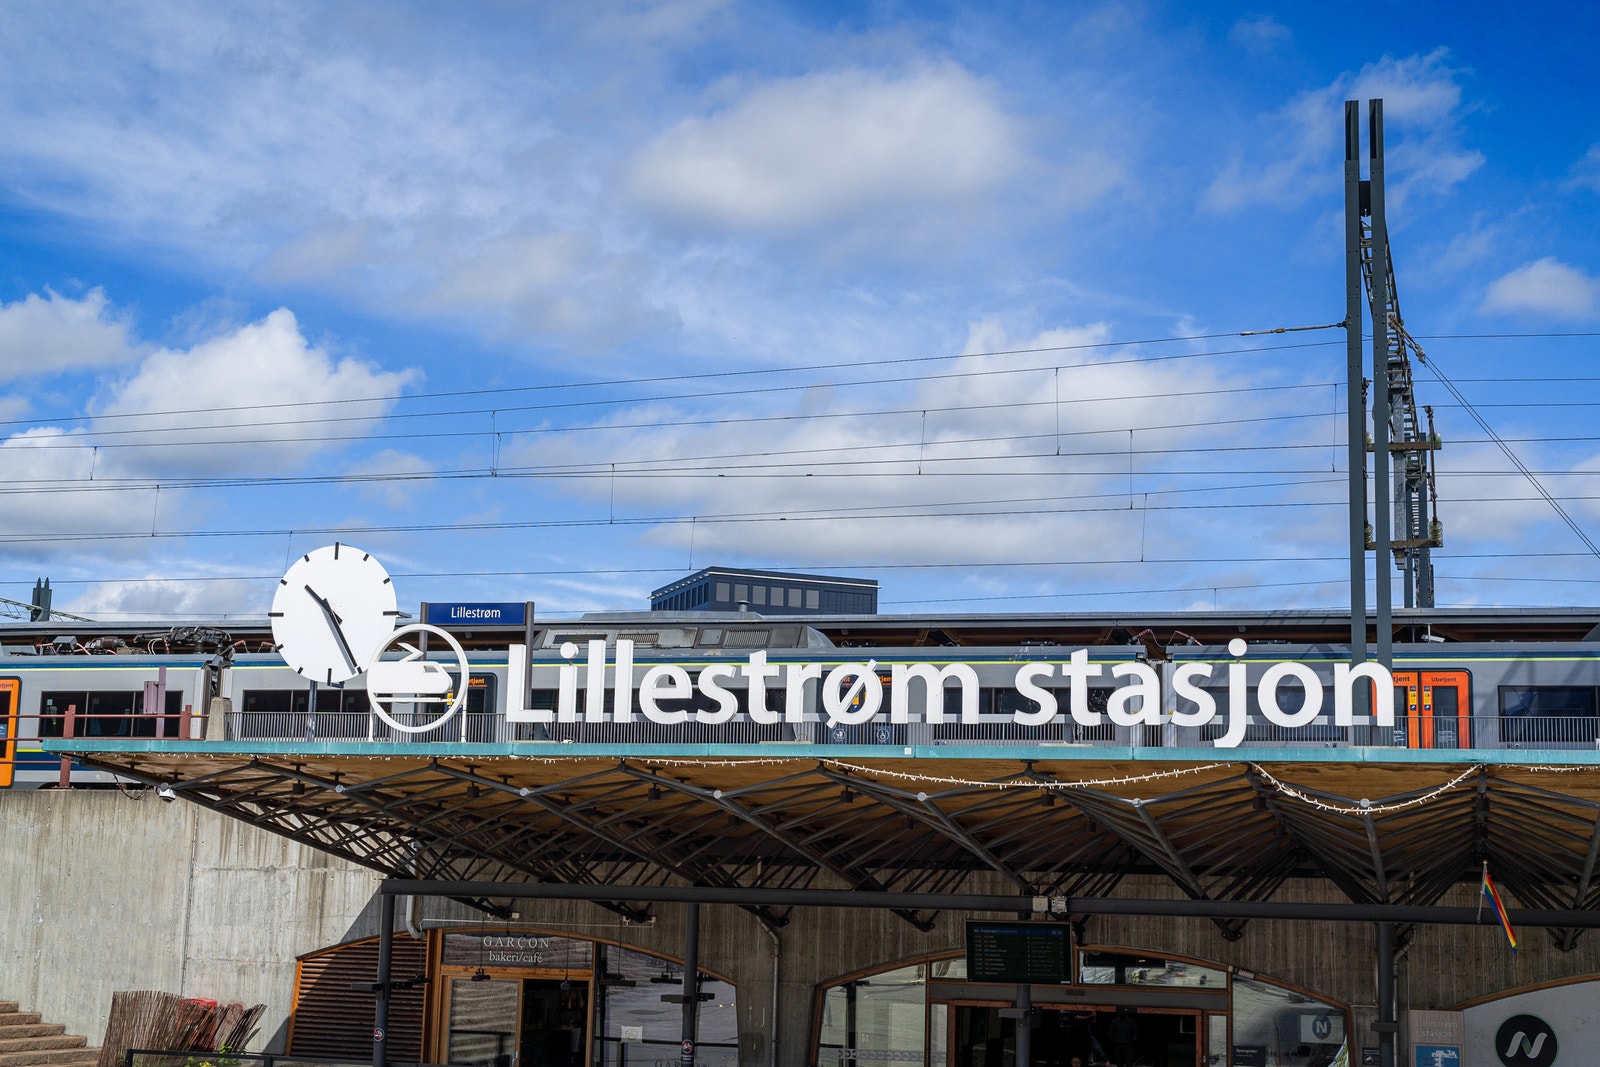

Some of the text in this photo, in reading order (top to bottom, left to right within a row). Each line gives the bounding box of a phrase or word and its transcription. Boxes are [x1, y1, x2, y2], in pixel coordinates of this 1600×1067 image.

[451, 606, 501, 618] Lillestrøm
[506, 637, 1395, 748] Lillestrøm stasjon
[483, 935, 549, 950] GARÇON
[489, 950, 543, 963] bakeri/café
